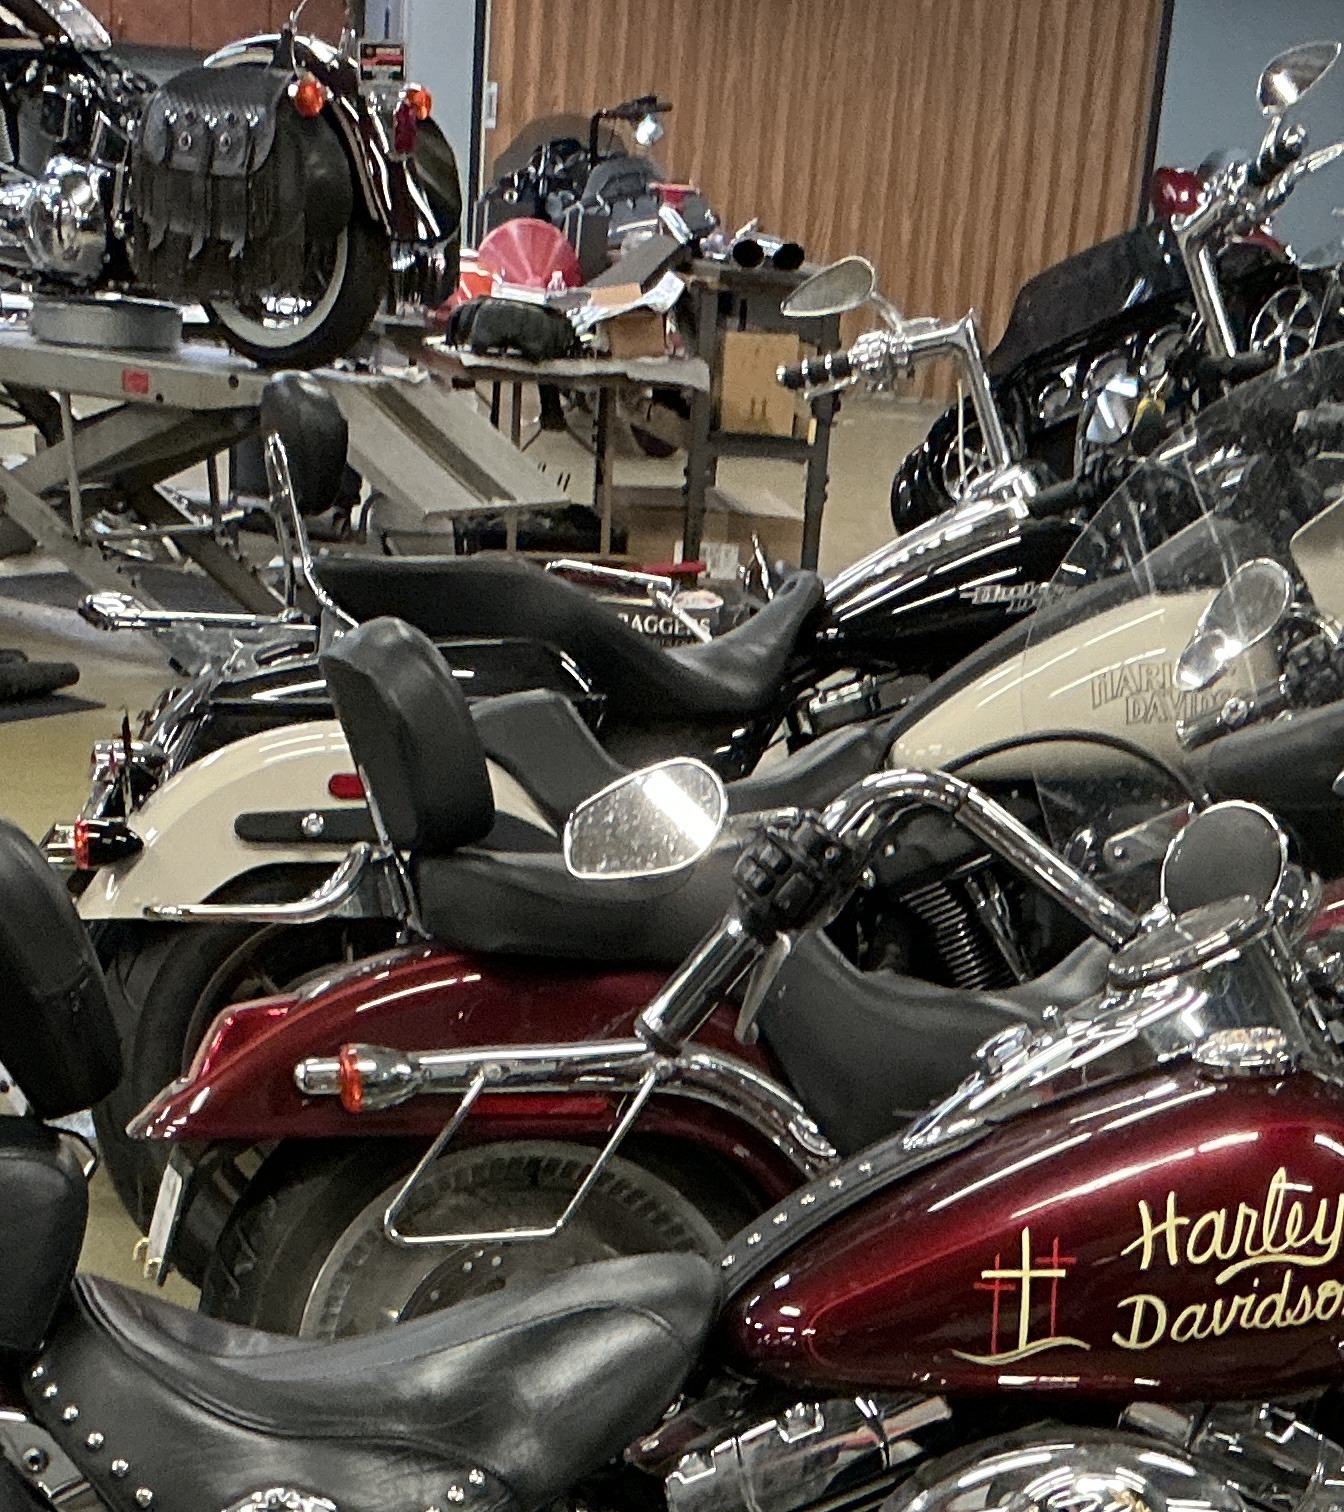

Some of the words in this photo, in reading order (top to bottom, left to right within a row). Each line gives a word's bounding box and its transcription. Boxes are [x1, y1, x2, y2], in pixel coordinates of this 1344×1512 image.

[617, 612, 711, 635] AGGES
[1090, 661, 1238, 710] HARL
[1125, 686, 1244, 726] DAVID
